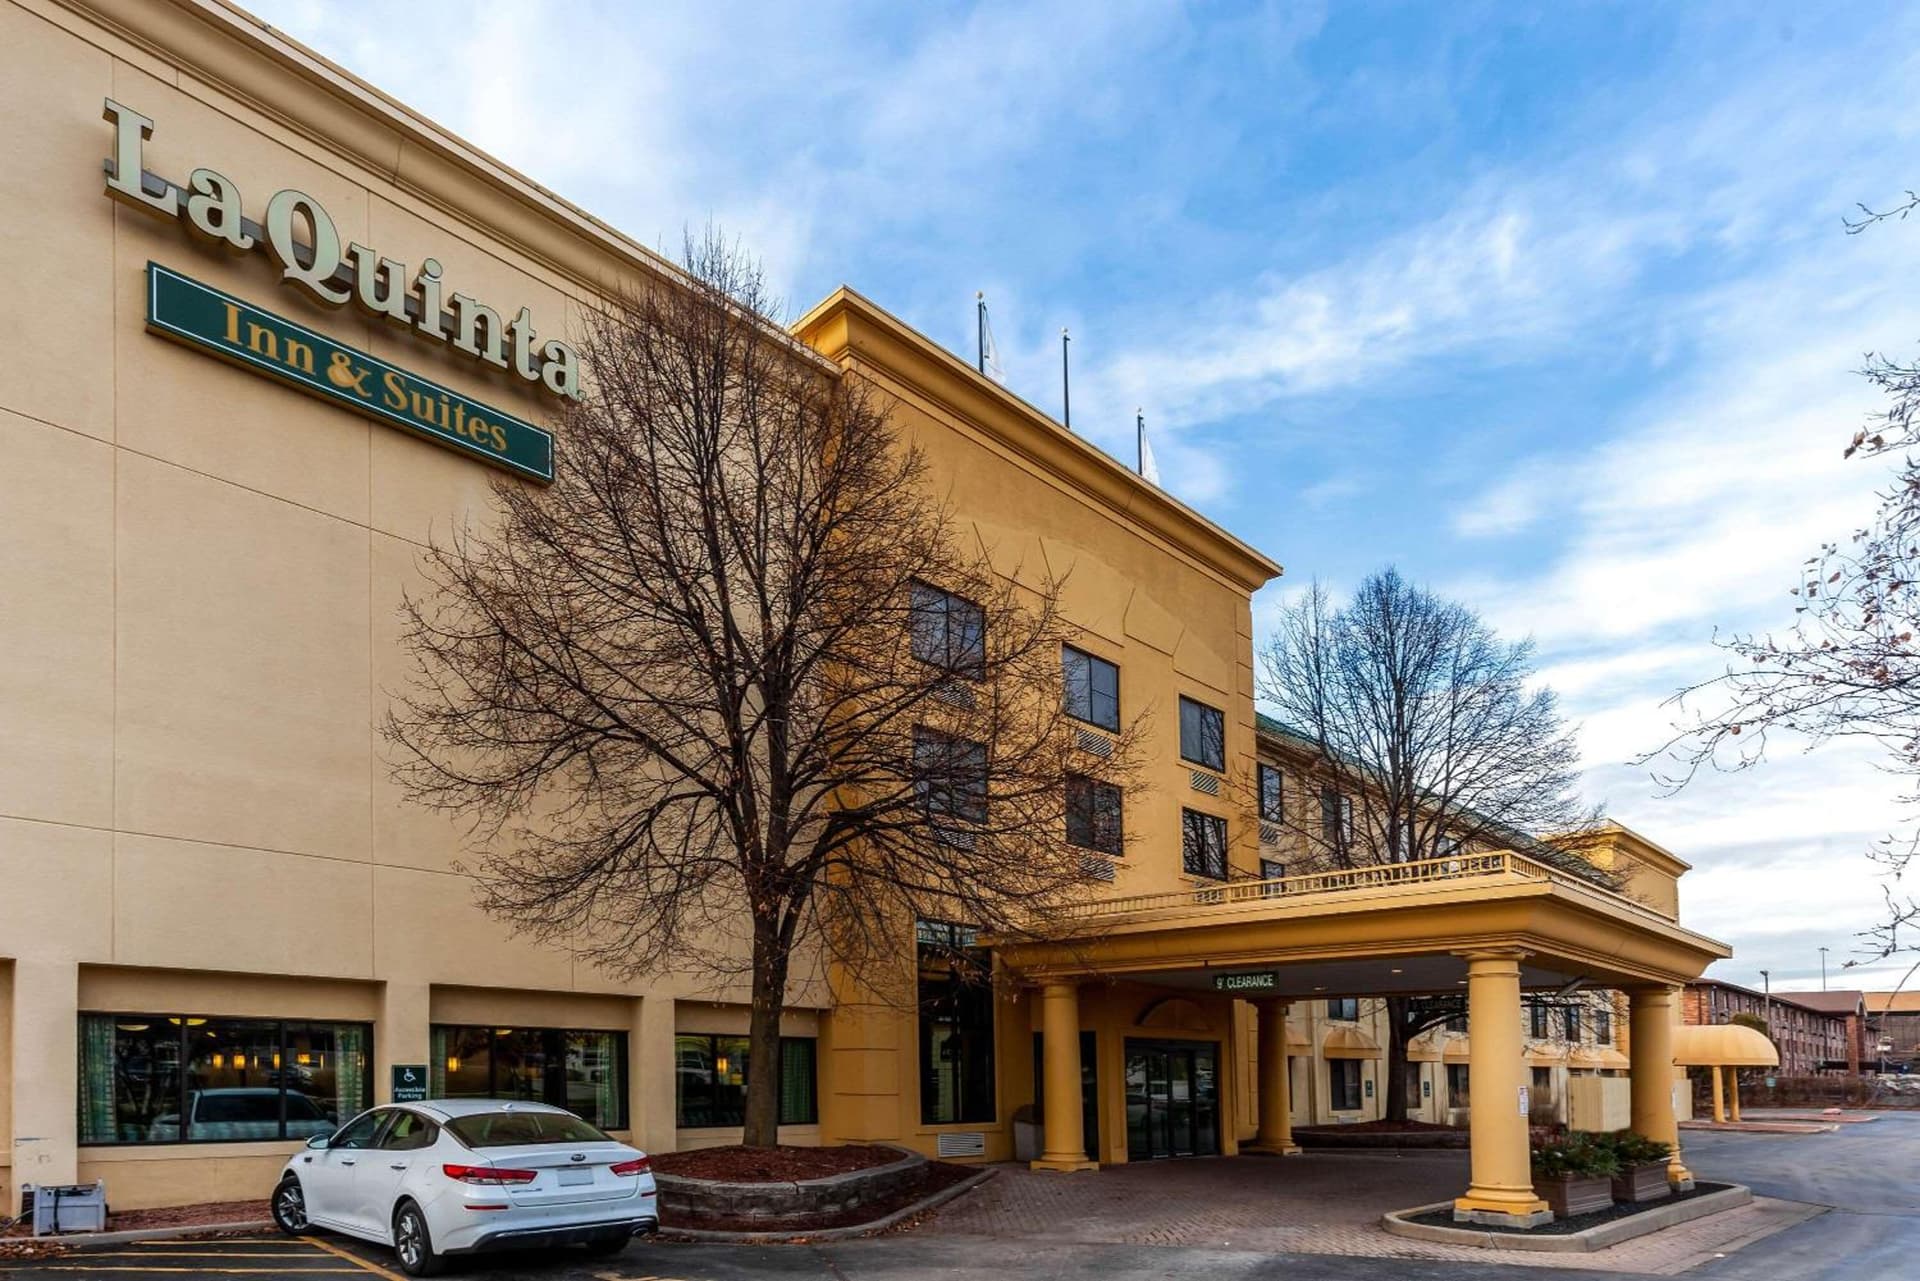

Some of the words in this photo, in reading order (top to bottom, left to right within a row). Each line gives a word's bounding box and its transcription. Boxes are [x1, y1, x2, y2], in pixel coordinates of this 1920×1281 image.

[104, 97, 254, 252] La
[265, 188, 586, 402] Quinta
[222, 302, 317, 376] Inn
[327, 351, 372, 398] &
[383, 371, 508, 452] Suites
[1226, 974, 1274, 989] CLEARANCE
